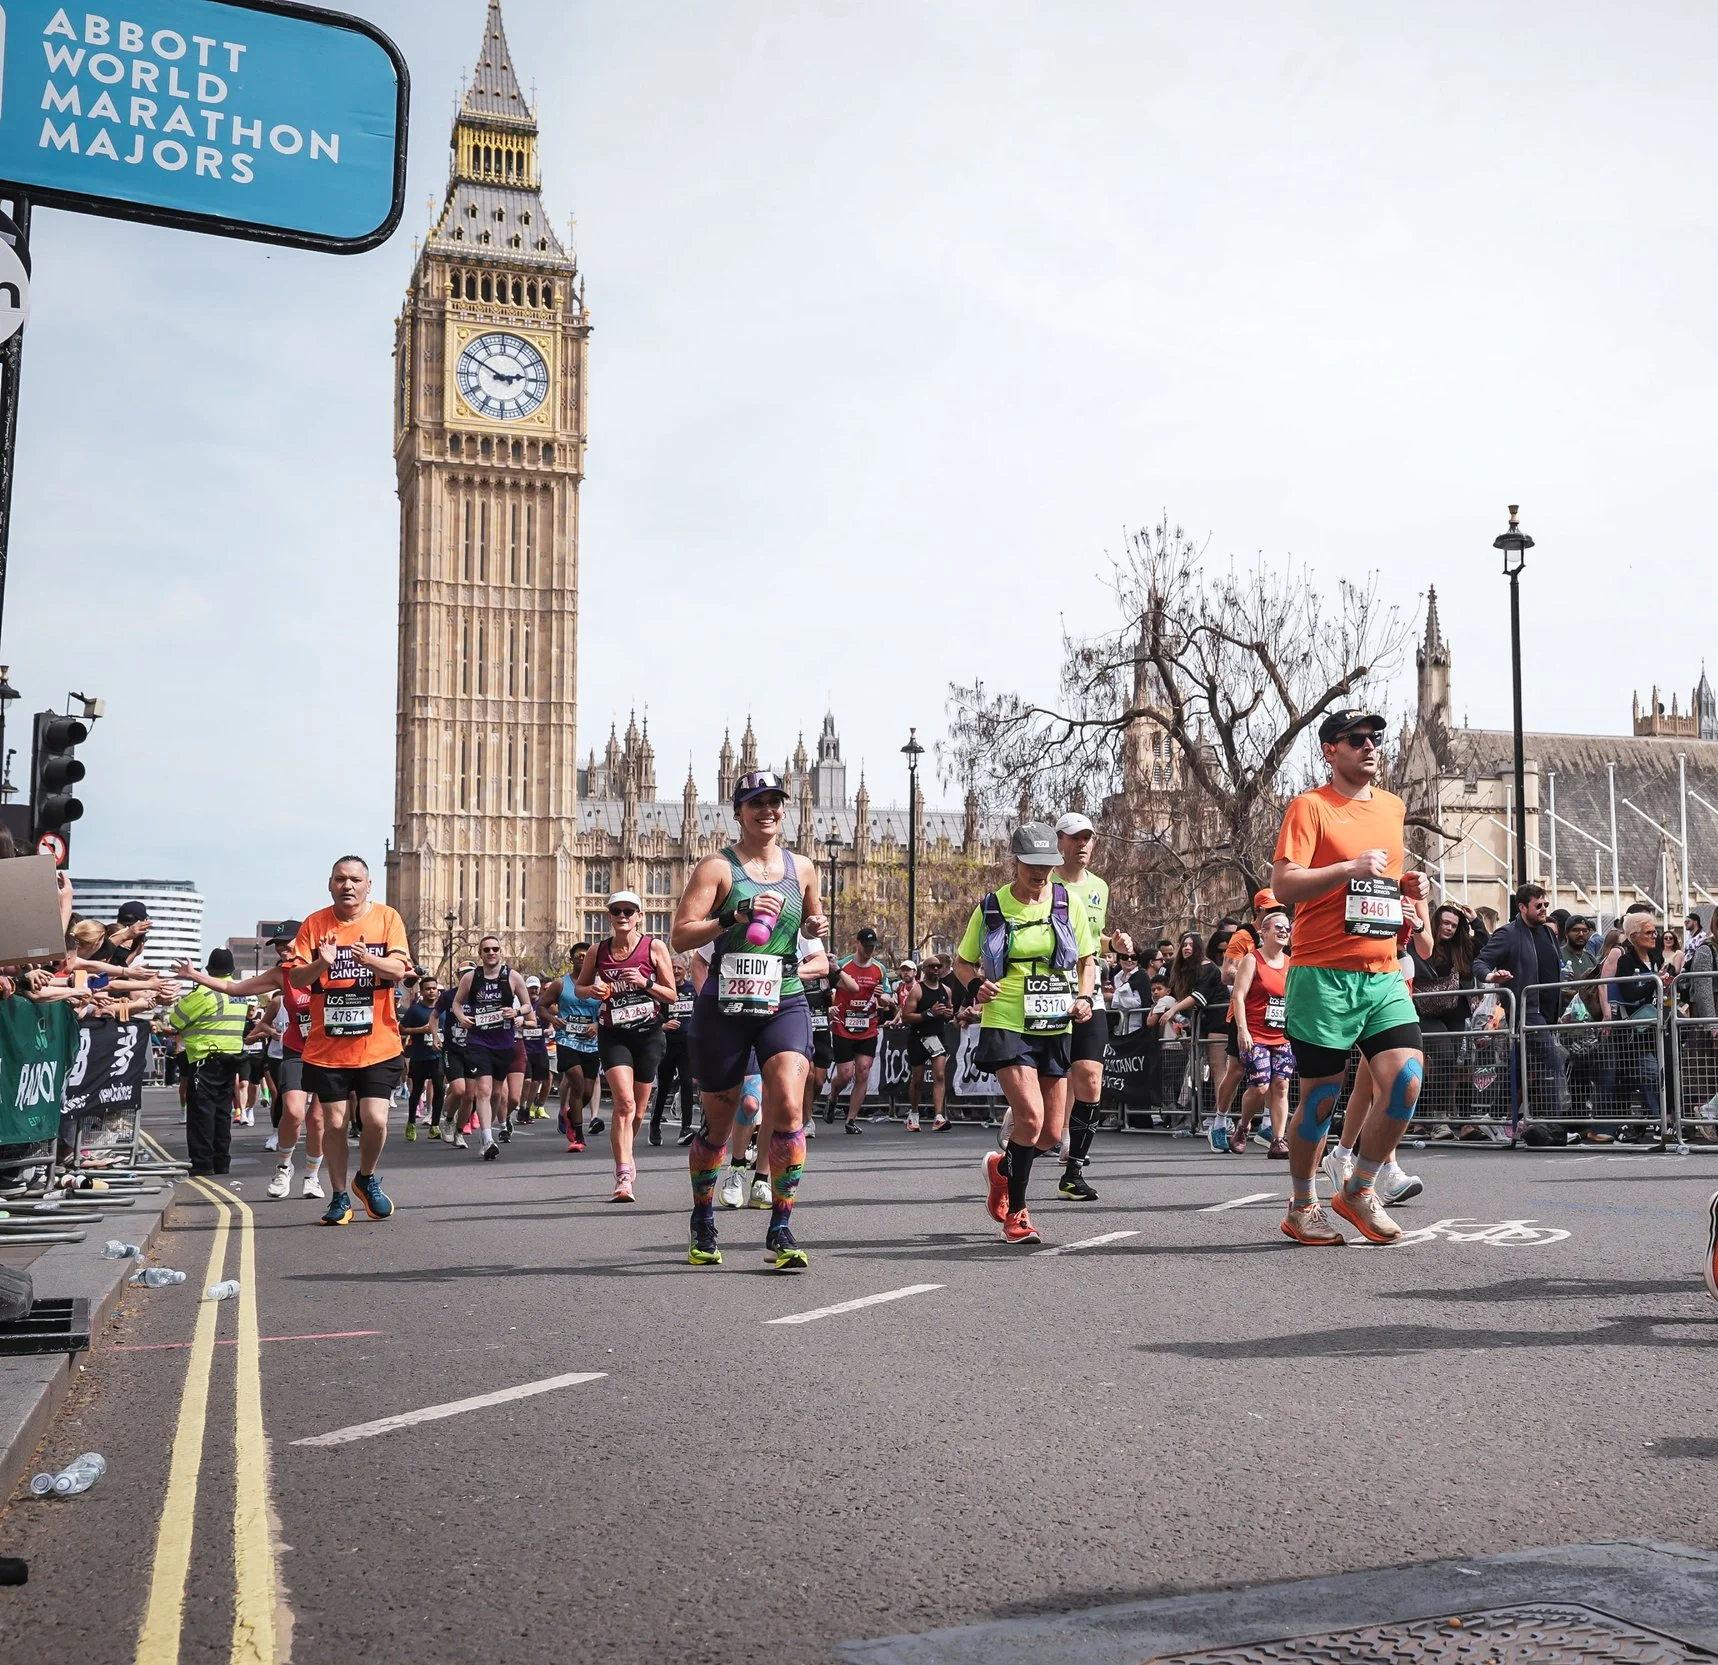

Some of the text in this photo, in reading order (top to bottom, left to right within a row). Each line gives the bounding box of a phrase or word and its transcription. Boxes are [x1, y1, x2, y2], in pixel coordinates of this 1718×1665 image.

[43, 8, 247, 73] ABBOTT
[43, 41, 228, 104] WORLD
[41, 80, 339, 164] MARATHON
[39, 117, 255, 184] MAJORS
[1351, 878, 1372, 893] tcs
[1361, 901, 1390, 918] 8461
[736, 959, 768, 975] HEIDY
[359, 979, 373, 987] UK
[728, 980, 772, 996] 28279
[1027, 978, 1048, 991] tcs
[327, 994, 344, 1005] tcs
[613, 997, 627, 1008] tcs
[1035, 999, 1066, 1013] 53170
[1269, 997, 1280, 1005] tcs
[332, 1010, 365, 1022] 47871
[724, 1003, 743, 1013] NB
[754, 1007, 774, 1015] balance
